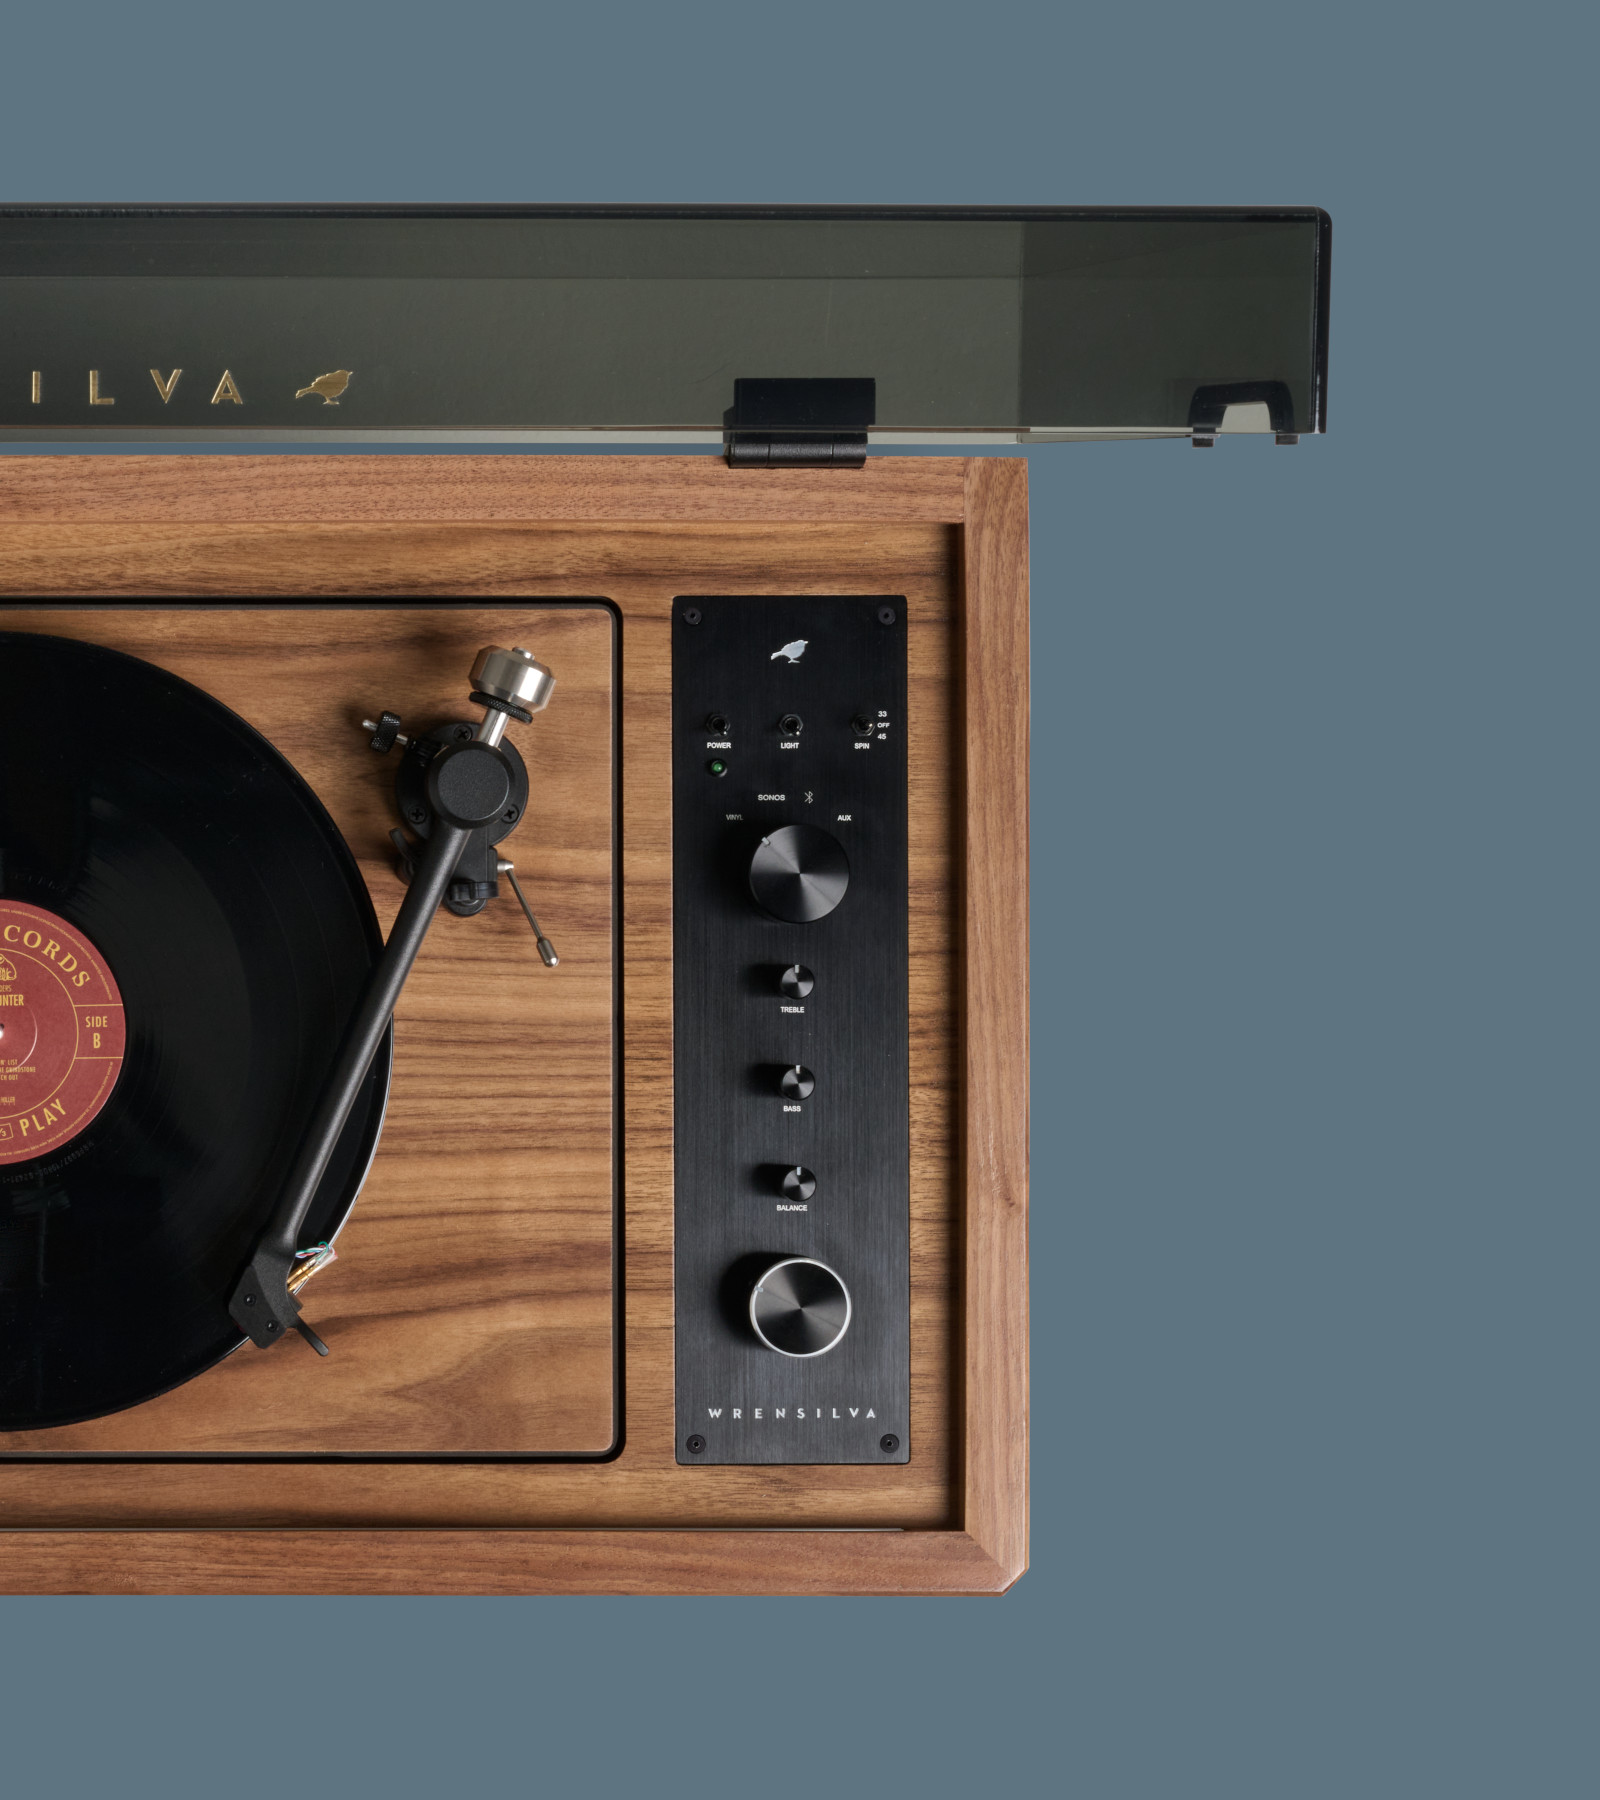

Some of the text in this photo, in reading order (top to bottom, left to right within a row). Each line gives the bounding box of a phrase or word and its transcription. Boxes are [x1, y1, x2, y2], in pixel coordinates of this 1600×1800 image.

[877, 710, 888, 718] 33
[877, 732, 887, 740] 45
[706, 741, 732, 749] POWER
[780, 741, 800, 750] LIGHT
[854, 742, 870, 750] SPIN
[725, 813, 744, 821] VINYL
[837, 814, 852, 822] AUX
[779, 1006, 805, 1014] TREBLE
[85, 1015, 109, 1028] SIDE
[92, 1032, 101, 1049] B
[782, 1105, 802, 1113] BASS
[19, 1097, 69, 1137] PLAY
[775, 1204, 809, 1212] BALANCE
[707, 1407, 878, 1419] WRENSILVA
